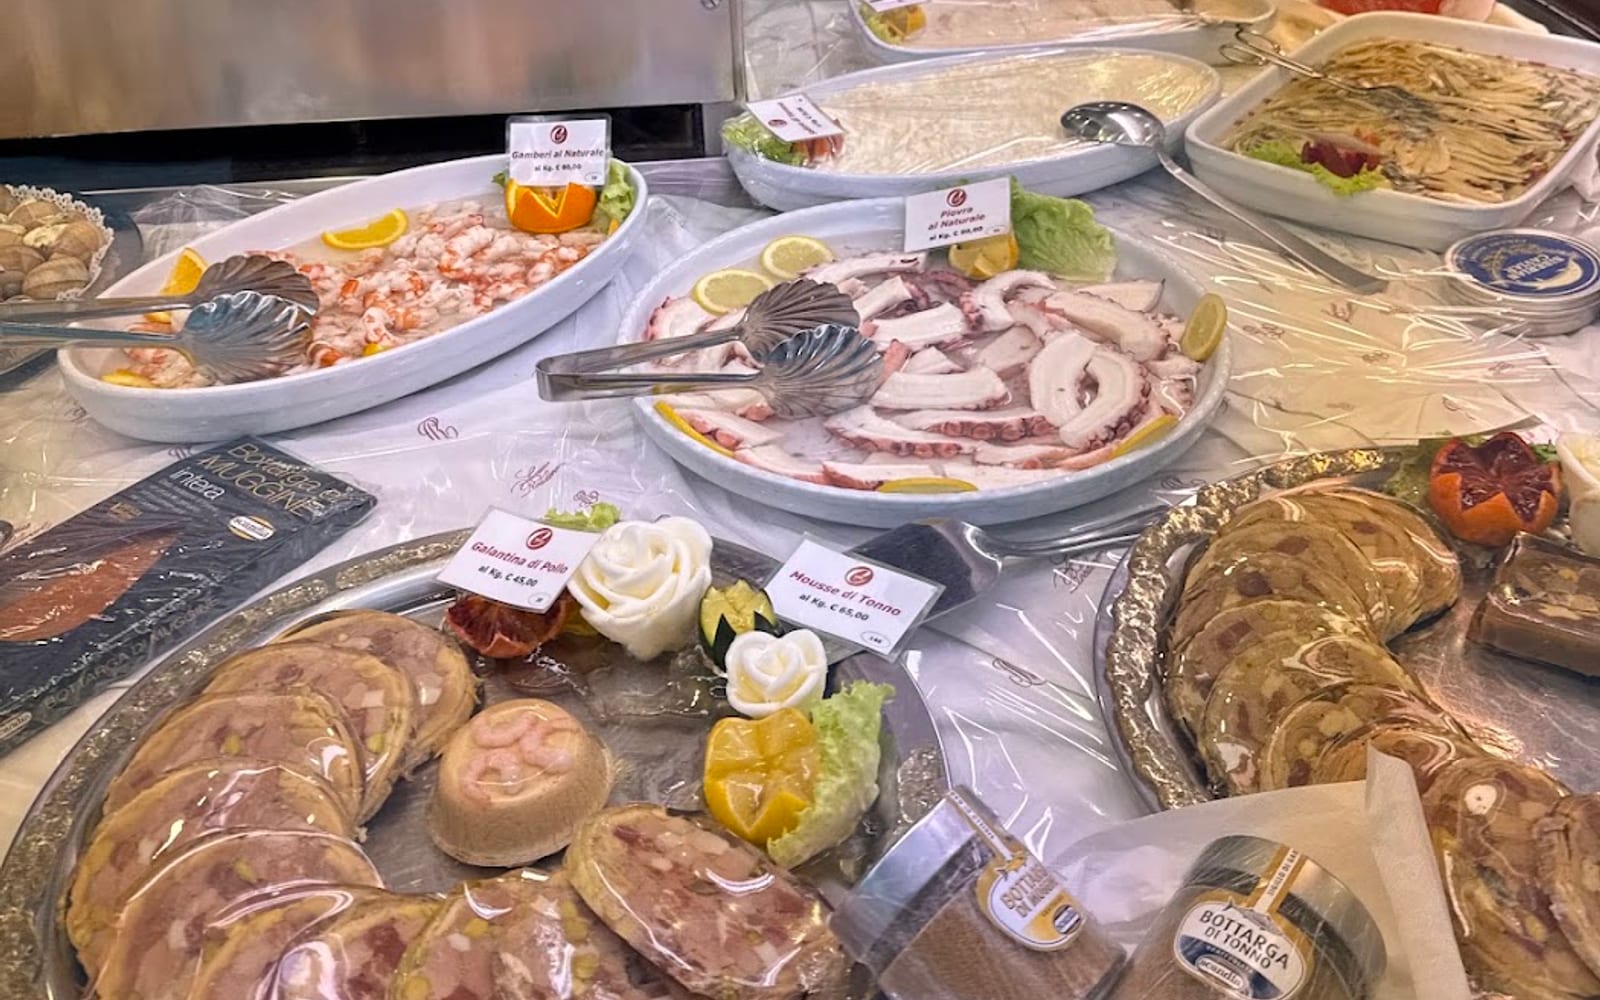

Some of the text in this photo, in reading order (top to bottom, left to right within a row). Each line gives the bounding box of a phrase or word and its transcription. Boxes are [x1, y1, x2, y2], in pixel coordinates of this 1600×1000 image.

[564, 148, 604, 158] Naturale
[927, 214, 986, 231] al Naturale
[940, 207, 974, 218] Piovra
[170, 466, 226, 500] intera
[227, 443, 321, 493] Bottarga
[471, 541, 569, 575] Galantina di Pollo
[478, 564, 488, 573] al
[487, 568, 503, 580] Kg.
[513, 575, 539, 588] 45,00
[789, 570, 902, 617] Mousse di Tonno
[799, 592, 810, 601] al
[810, 597, 827, 609] Kg.
[838, 607, 870, 622] 65,00
[1200, 909, 1290, 970] BOTTARGA
[1204, 927, 1219, 940] DI
[1223, 933, 1272, 970] TONNO
